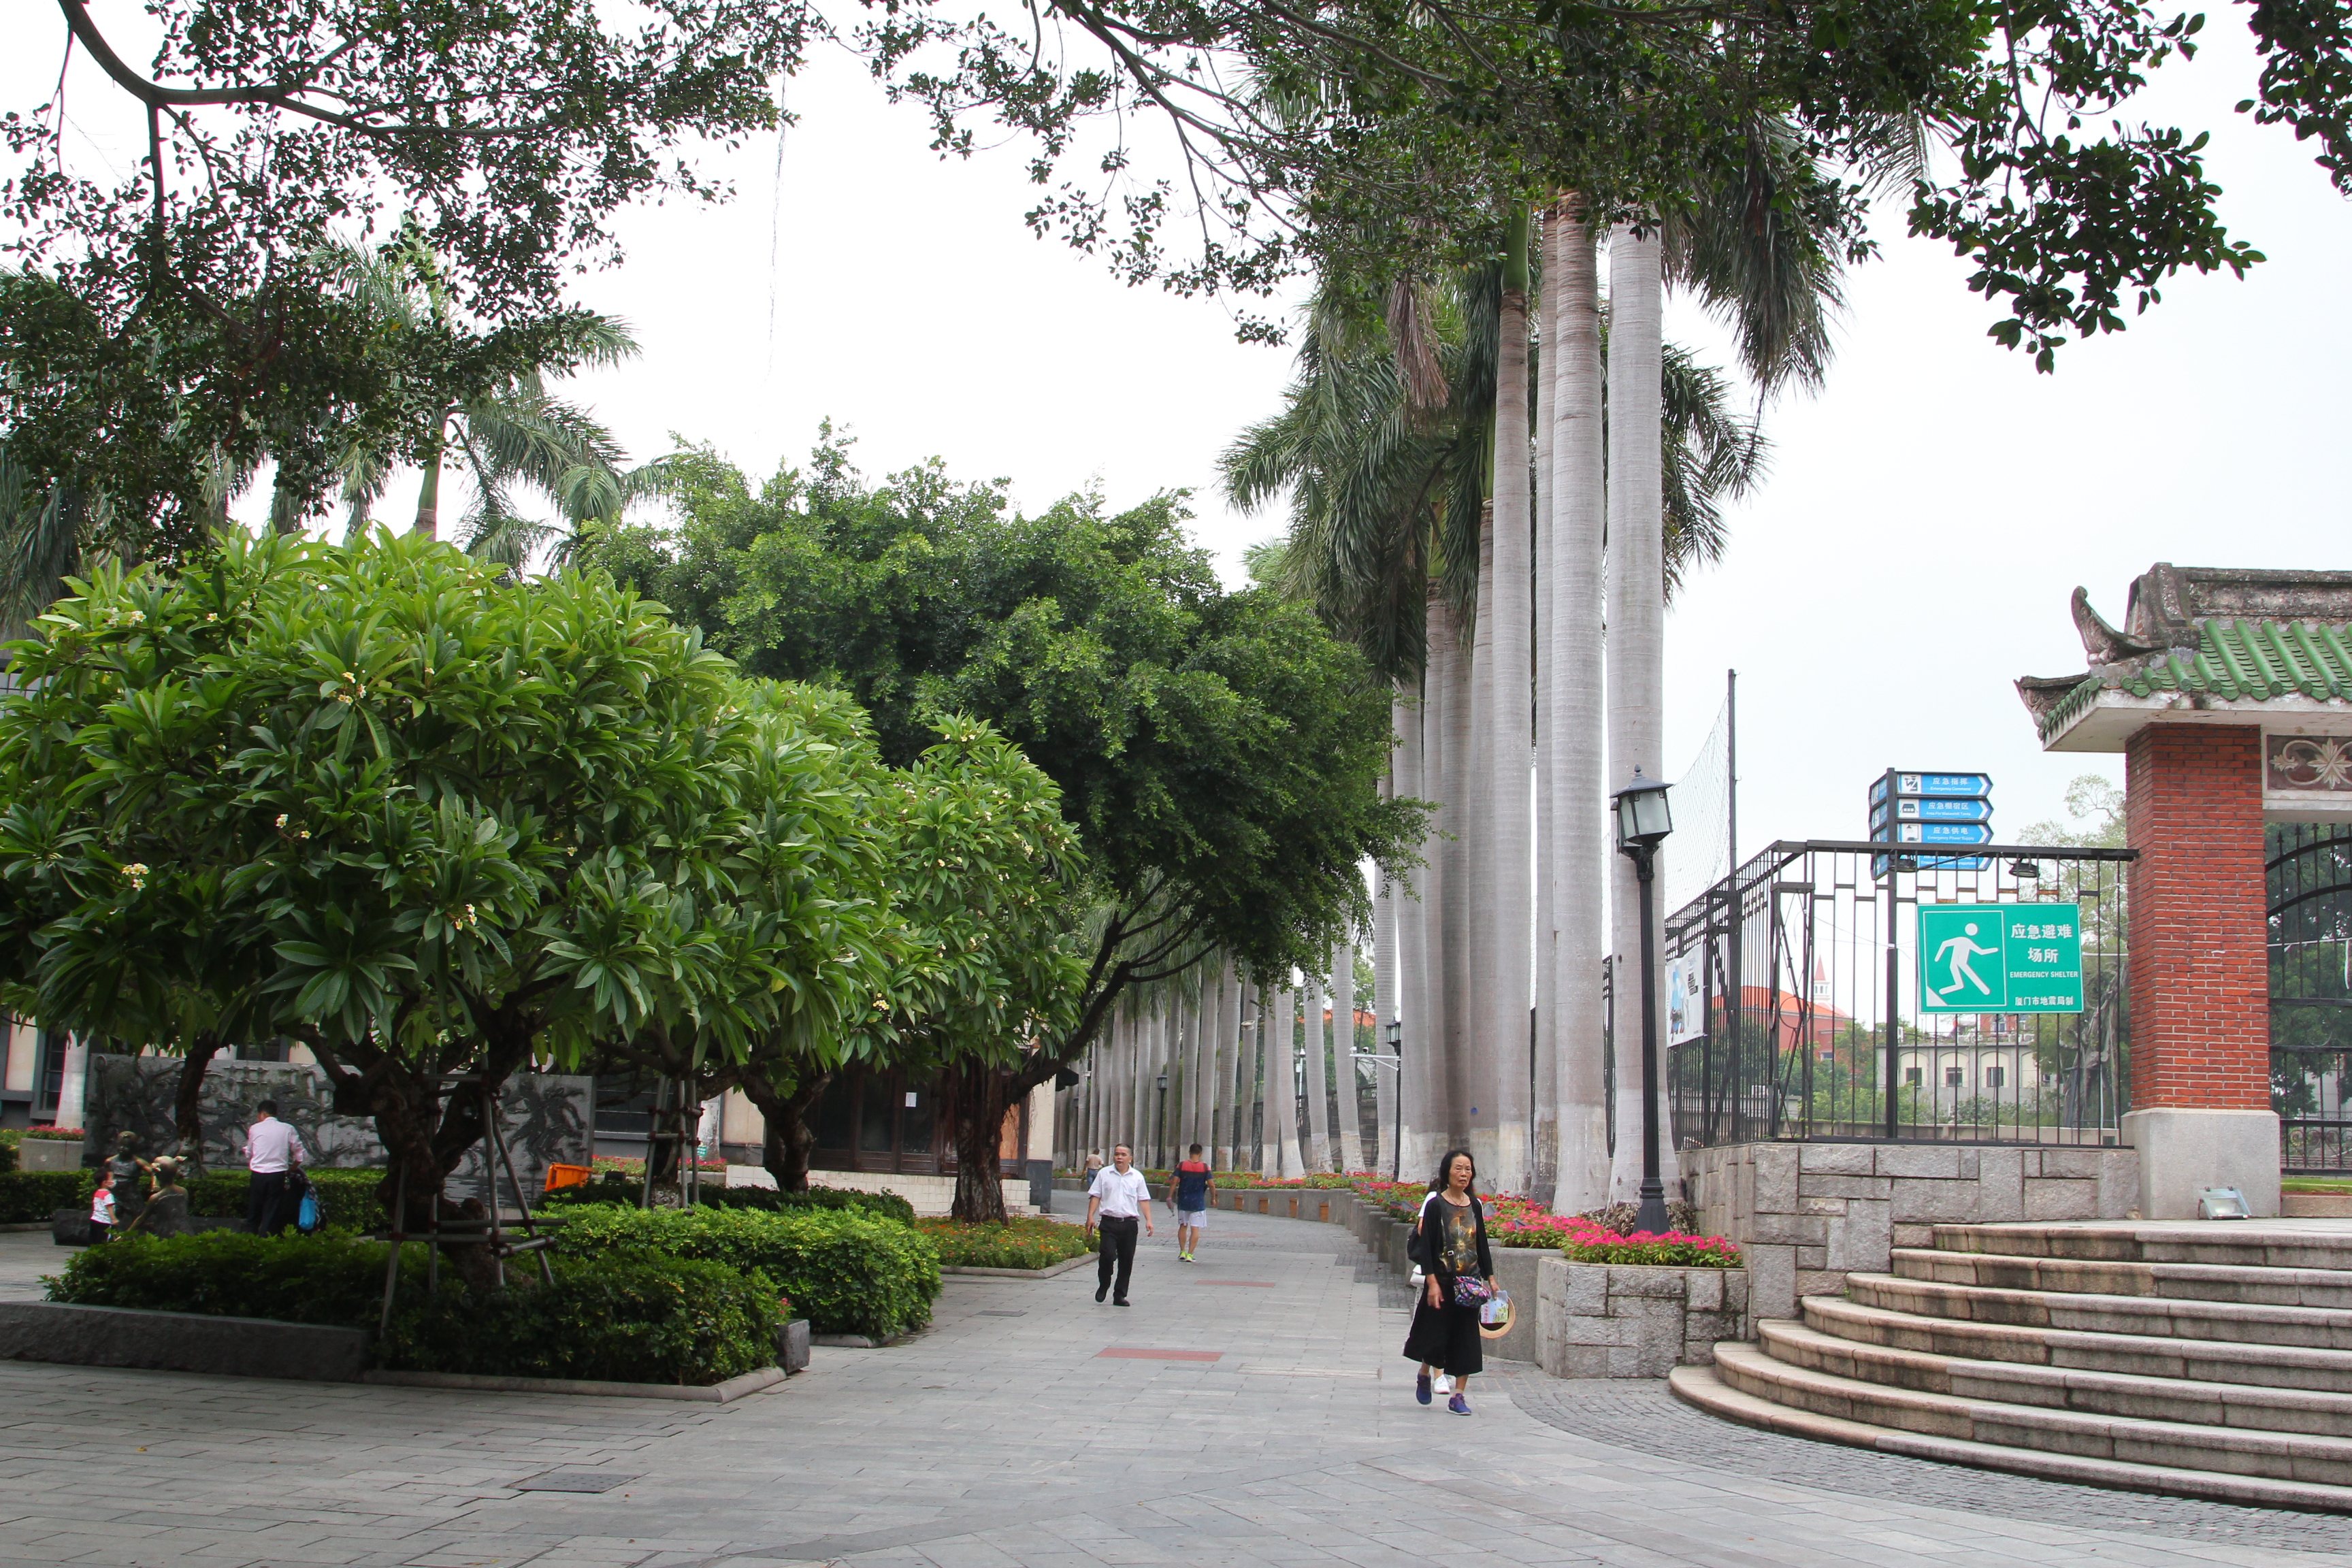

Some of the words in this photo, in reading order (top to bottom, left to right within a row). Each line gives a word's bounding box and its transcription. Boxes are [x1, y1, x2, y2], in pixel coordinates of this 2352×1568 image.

[1933, 777, 1968, 786] 应急指挥
[1928, 802, 1969, 810] 应急棚宿区
[1933, 826, 1969, 835] 应急供电
[2011, 924, 2072, 939] 应急避难
[2027, 947, 2059, 963] 场所
[2015, 996, 2074, 1006] 厦门市地震局制
